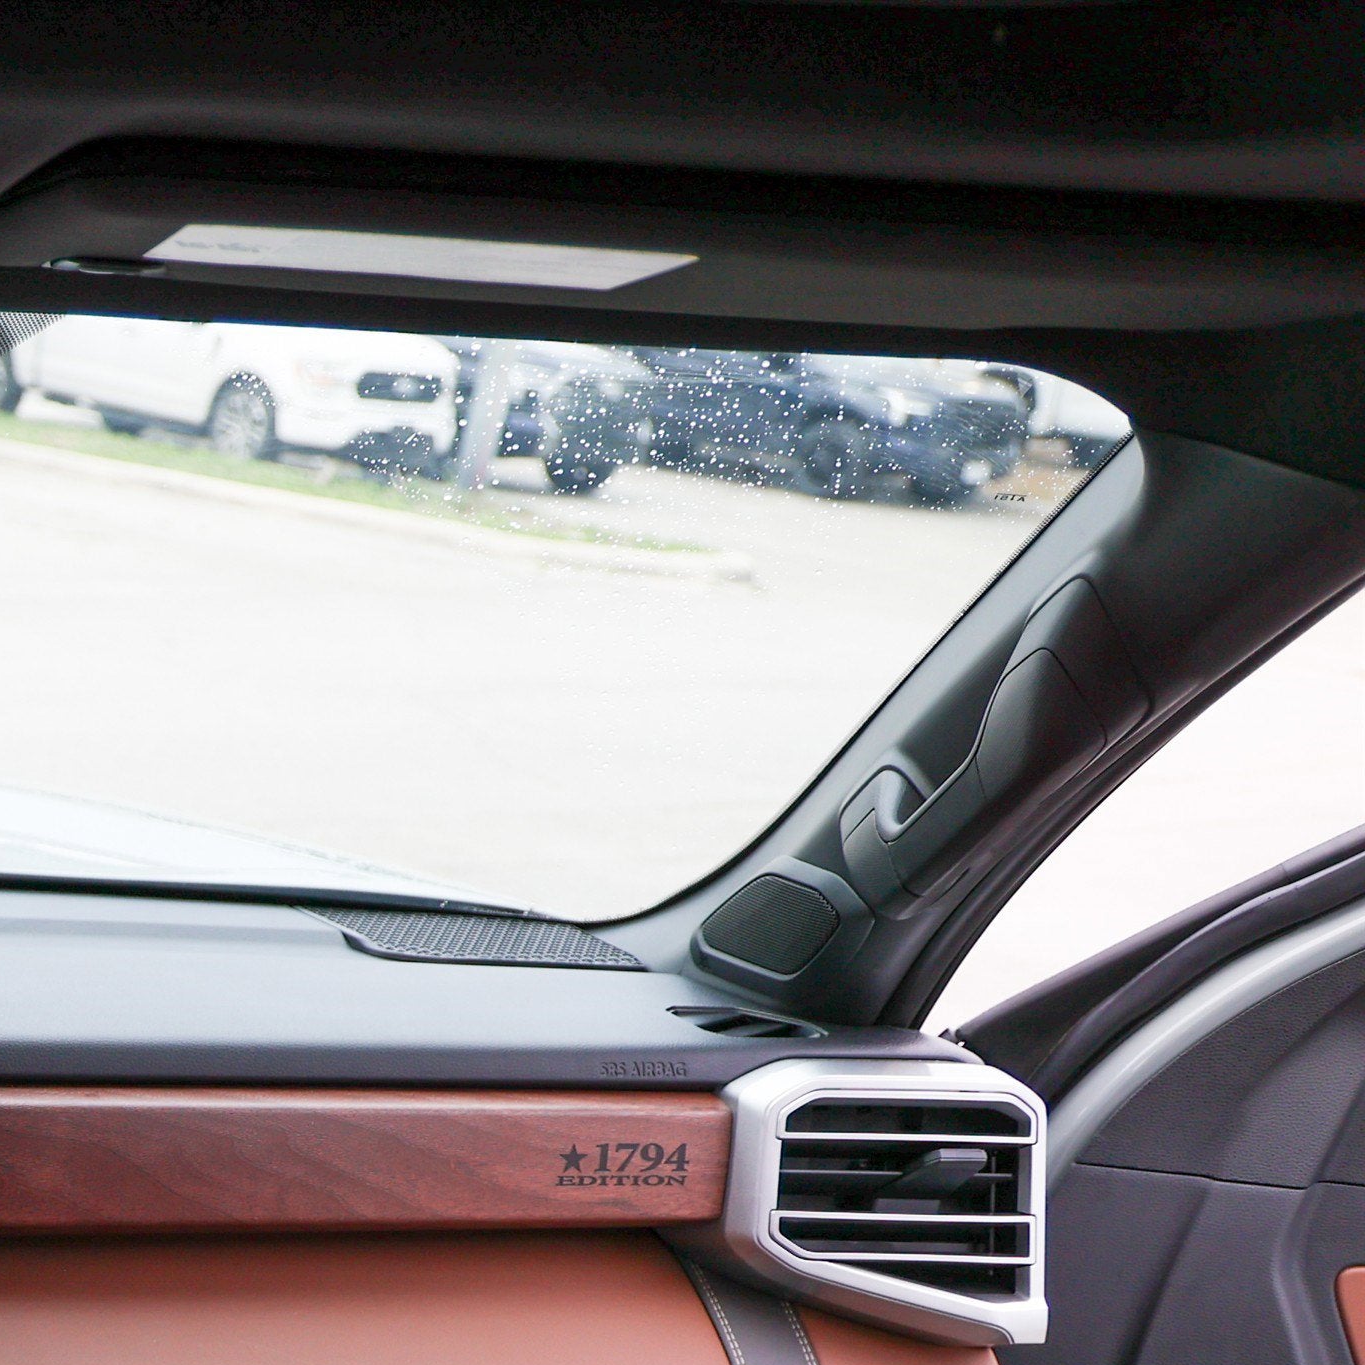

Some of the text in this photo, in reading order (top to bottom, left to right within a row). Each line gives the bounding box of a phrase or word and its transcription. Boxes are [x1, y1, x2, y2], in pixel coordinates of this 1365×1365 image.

[600, 1061, 688, 1078] SRS AIRBAG
[595, 1143, 690, 1173] 1794
[556, 1175, 687, 1187] EDITION
